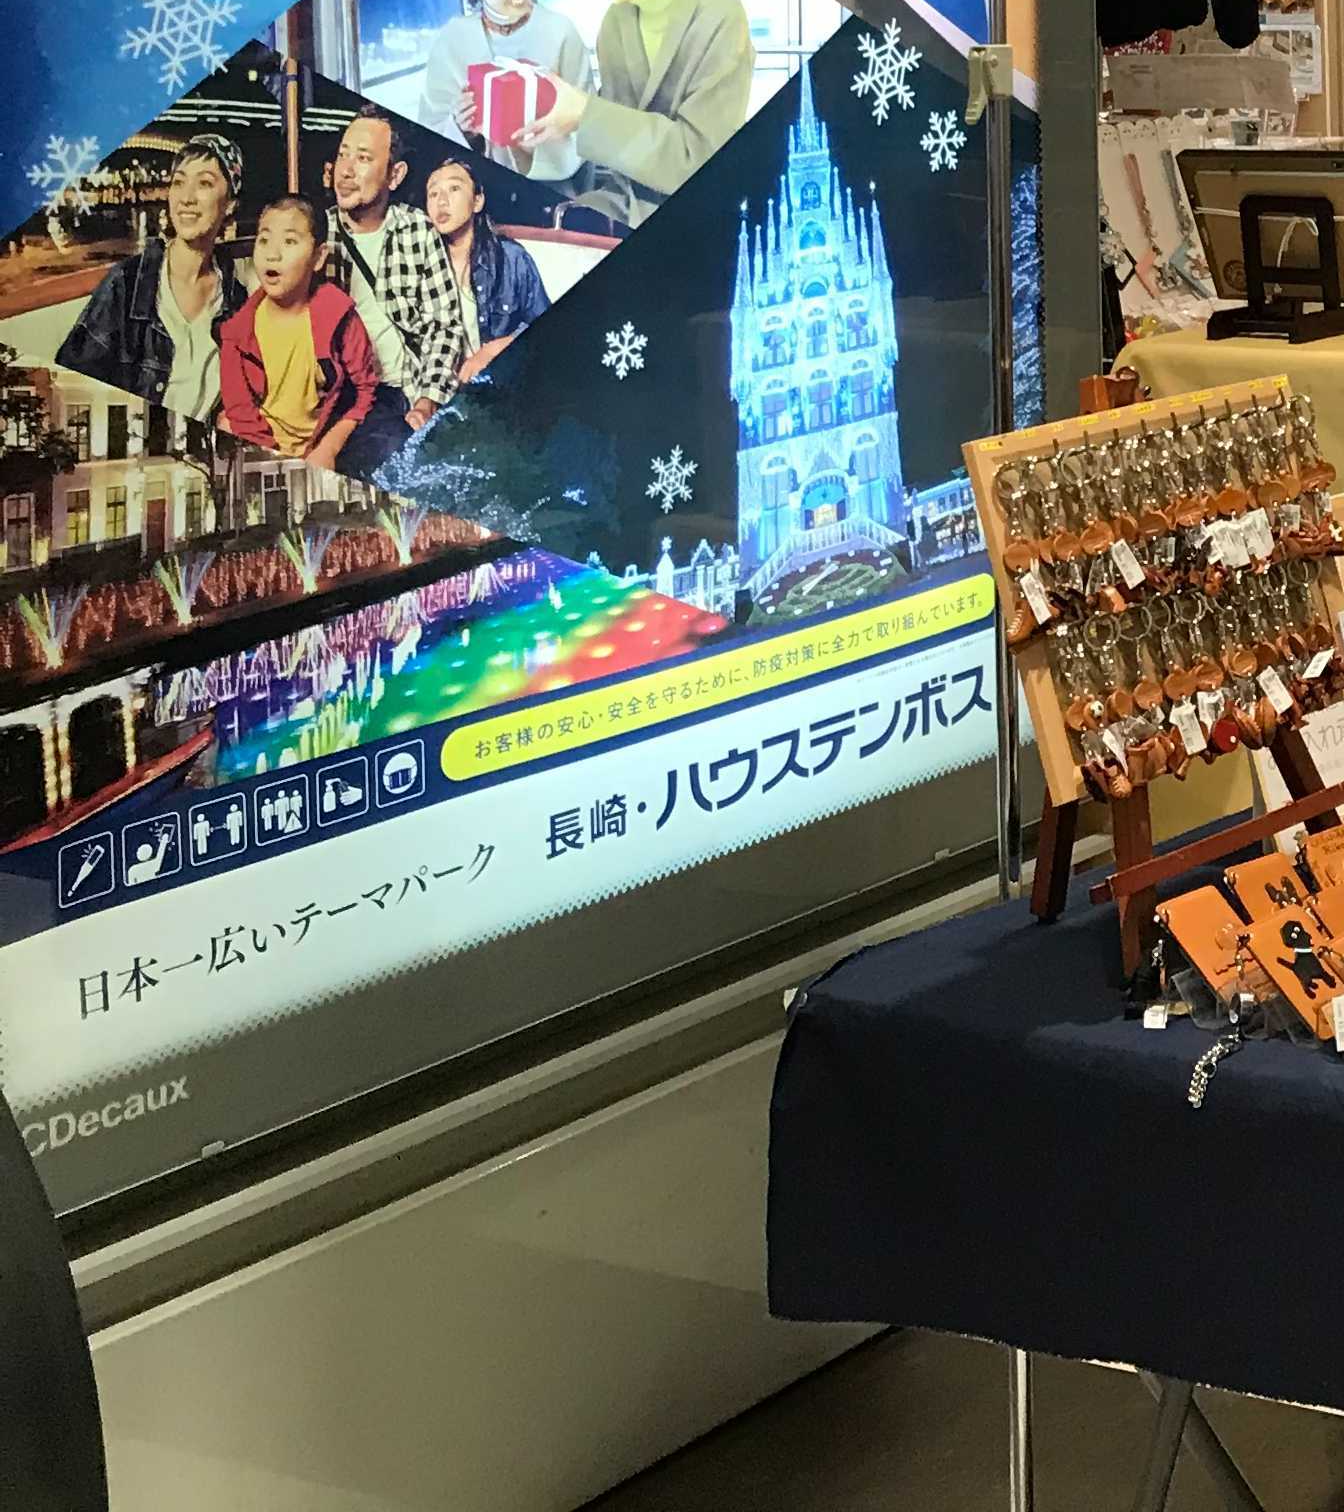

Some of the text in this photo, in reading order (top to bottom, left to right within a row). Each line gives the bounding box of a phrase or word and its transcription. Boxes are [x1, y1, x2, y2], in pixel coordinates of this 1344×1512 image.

[475, 594, 984, 759] お客様の安心・安全を守るために、防疫対策に全力で取り組んでいます。
[546, 665, 992, 860] 長崎・ハウステンボス
[78, 842, 497, 1022] 日本一広いテーマパーク
